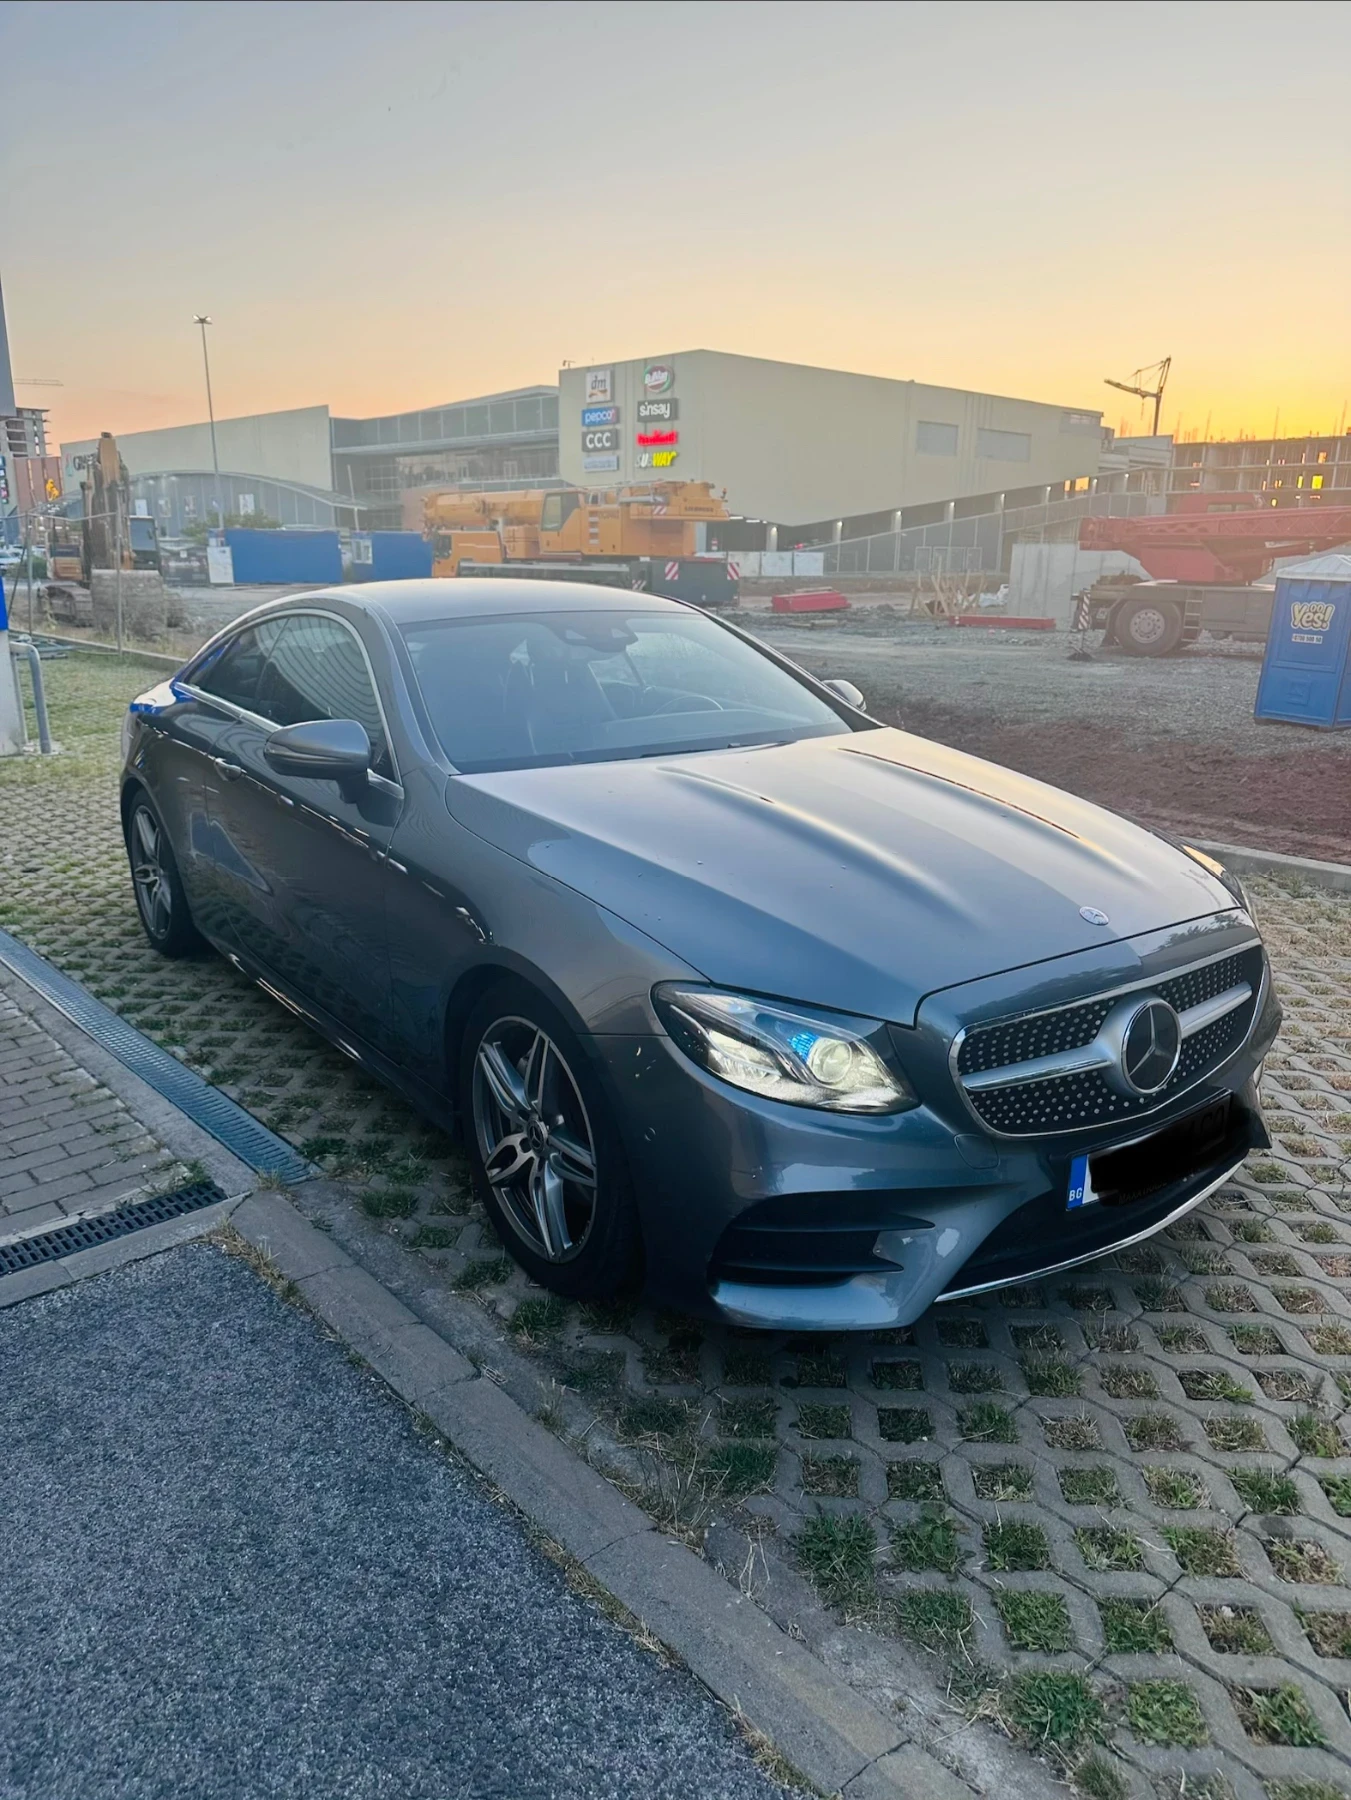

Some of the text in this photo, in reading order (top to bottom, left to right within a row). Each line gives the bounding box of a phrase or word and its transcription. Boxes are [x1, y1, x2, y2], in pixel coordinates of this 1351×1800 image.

[591, 375, 607, 389] dm
[585, 409, 613, 424] pepco
[640, 401, 670, 418] sinsay
[586, 432, 611, 448] CCC
[1069, 1188, 1082, 1201] BG
